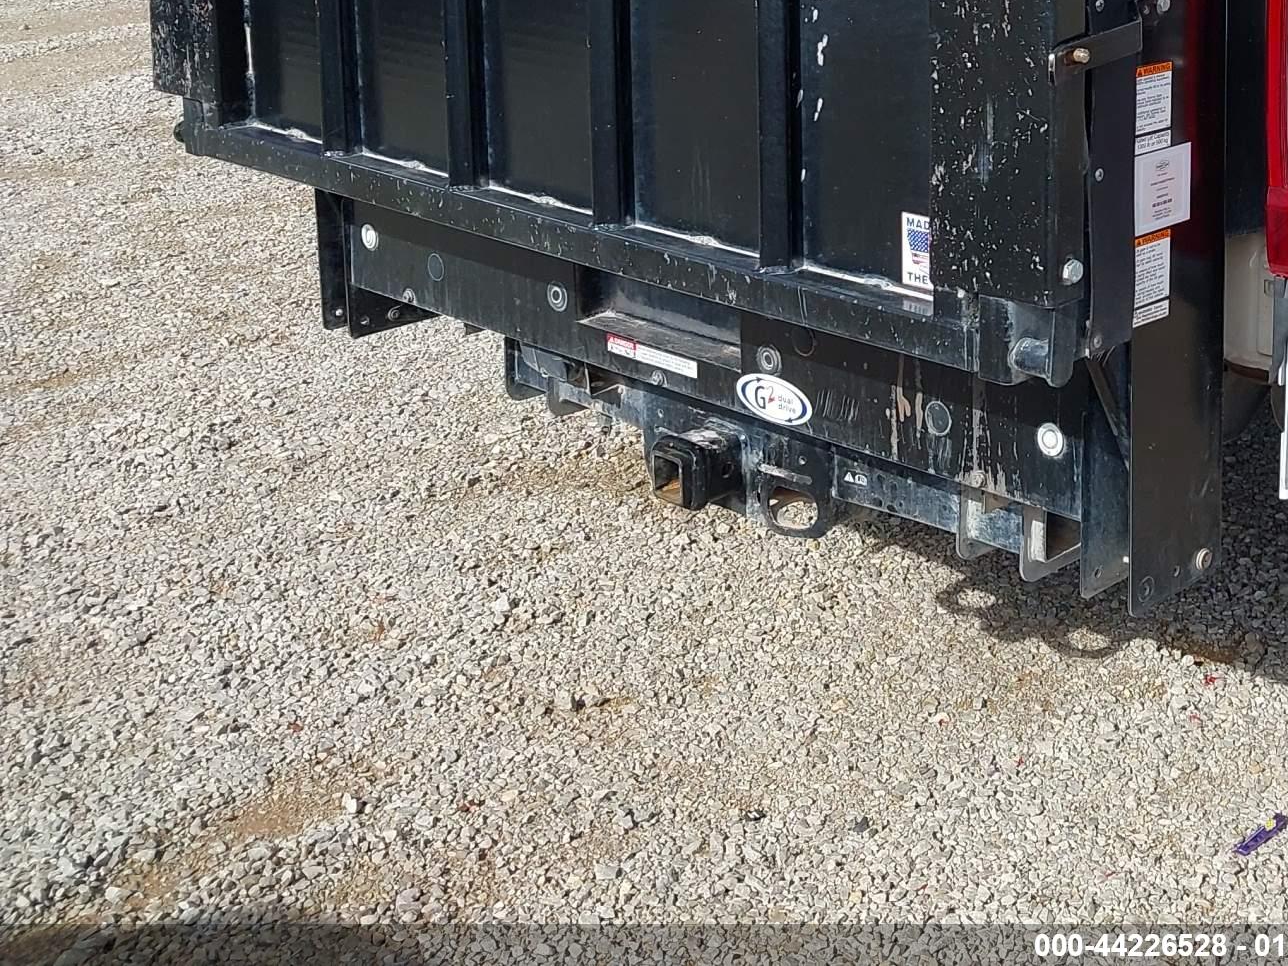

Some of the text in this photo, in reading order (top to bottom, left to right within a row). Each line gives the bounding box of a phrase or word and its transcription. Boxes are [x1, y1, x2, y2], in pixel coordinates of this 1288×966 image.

[1143, 62, 1171, 76] WARNING
[906, 217, 930, 230] MAD
[907, 272, 929, 285] THE
[777, 393, 794, 405] dual
[777, 403, 797, 415] drive
